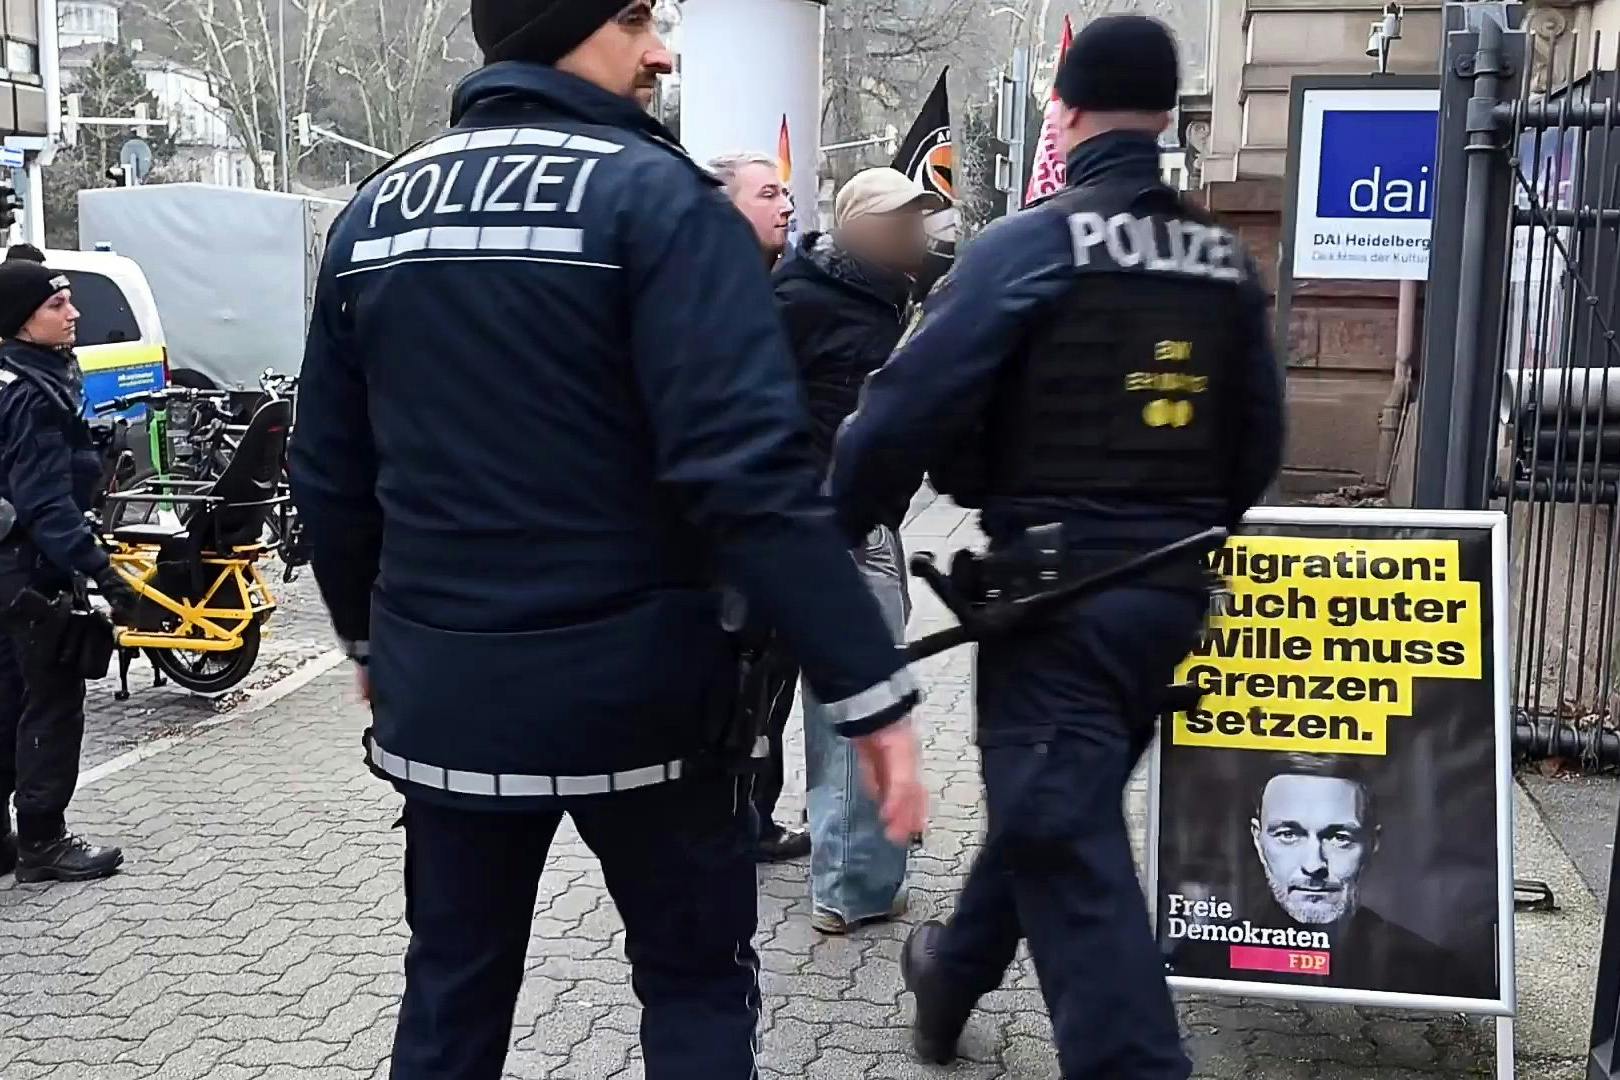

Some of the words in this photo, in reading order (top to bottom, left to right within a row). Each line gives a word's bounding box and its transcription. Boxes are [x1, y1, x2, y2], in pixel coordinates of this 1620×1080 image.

[367, 154, 599, 229] POLIZEI
[1350, 166, 1429, 213] dai
[1067, 211, 1246, 284] POLIZE
[1313, 233, 1341, 246] DAI
[1345, 234, 1431, 250] Heidelberg
[1212, 587, 1316, 619] uch
[1327, 591, 1467, 627] guter
[1323, 636, 1466, 666] muss
[1186, 664, 1398, 702] Grenzen
[1185, 705, 1373, 741] setzen.
[1168, 894, 1233, 919] Freie
[1168, 917, 1331, 949] Demokraten
[1288, 953, 1327, 970] FDP
